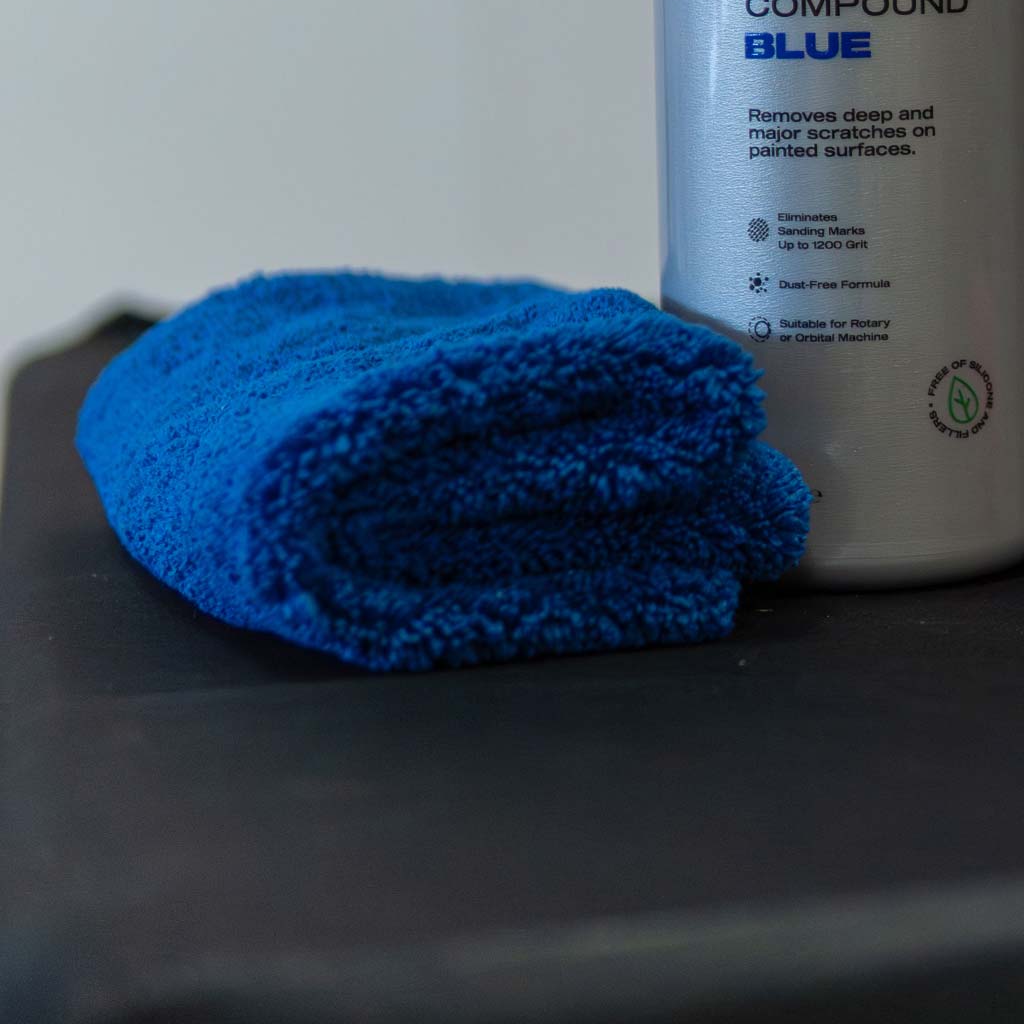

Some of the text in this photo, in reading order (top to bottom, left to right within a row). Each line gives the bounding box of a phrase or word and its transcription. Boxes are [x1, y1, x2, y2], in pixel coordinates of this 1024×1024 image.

[744, 31, 872, 60] BLUE
[748, 106, 934, 124] Removes deep and
[748, 124, 936, 143] major scratches on
[749, 142, 916, 160] painted surfaces.
[777, 212, 838, 222] Eliminates
[777, 225, 866, 238] Sanding Marks
[778, 239, 869, 251] Up to 1200 Grit
[778, 279, 891, 289] Dust-Free Formula
[779, 319, 891, 329] Suitable for Rotary
[780, 332, 889, 343] or Orbital Machine
[928, 366, 950, 396] FREE
[951, 359, 968, 370] OF
